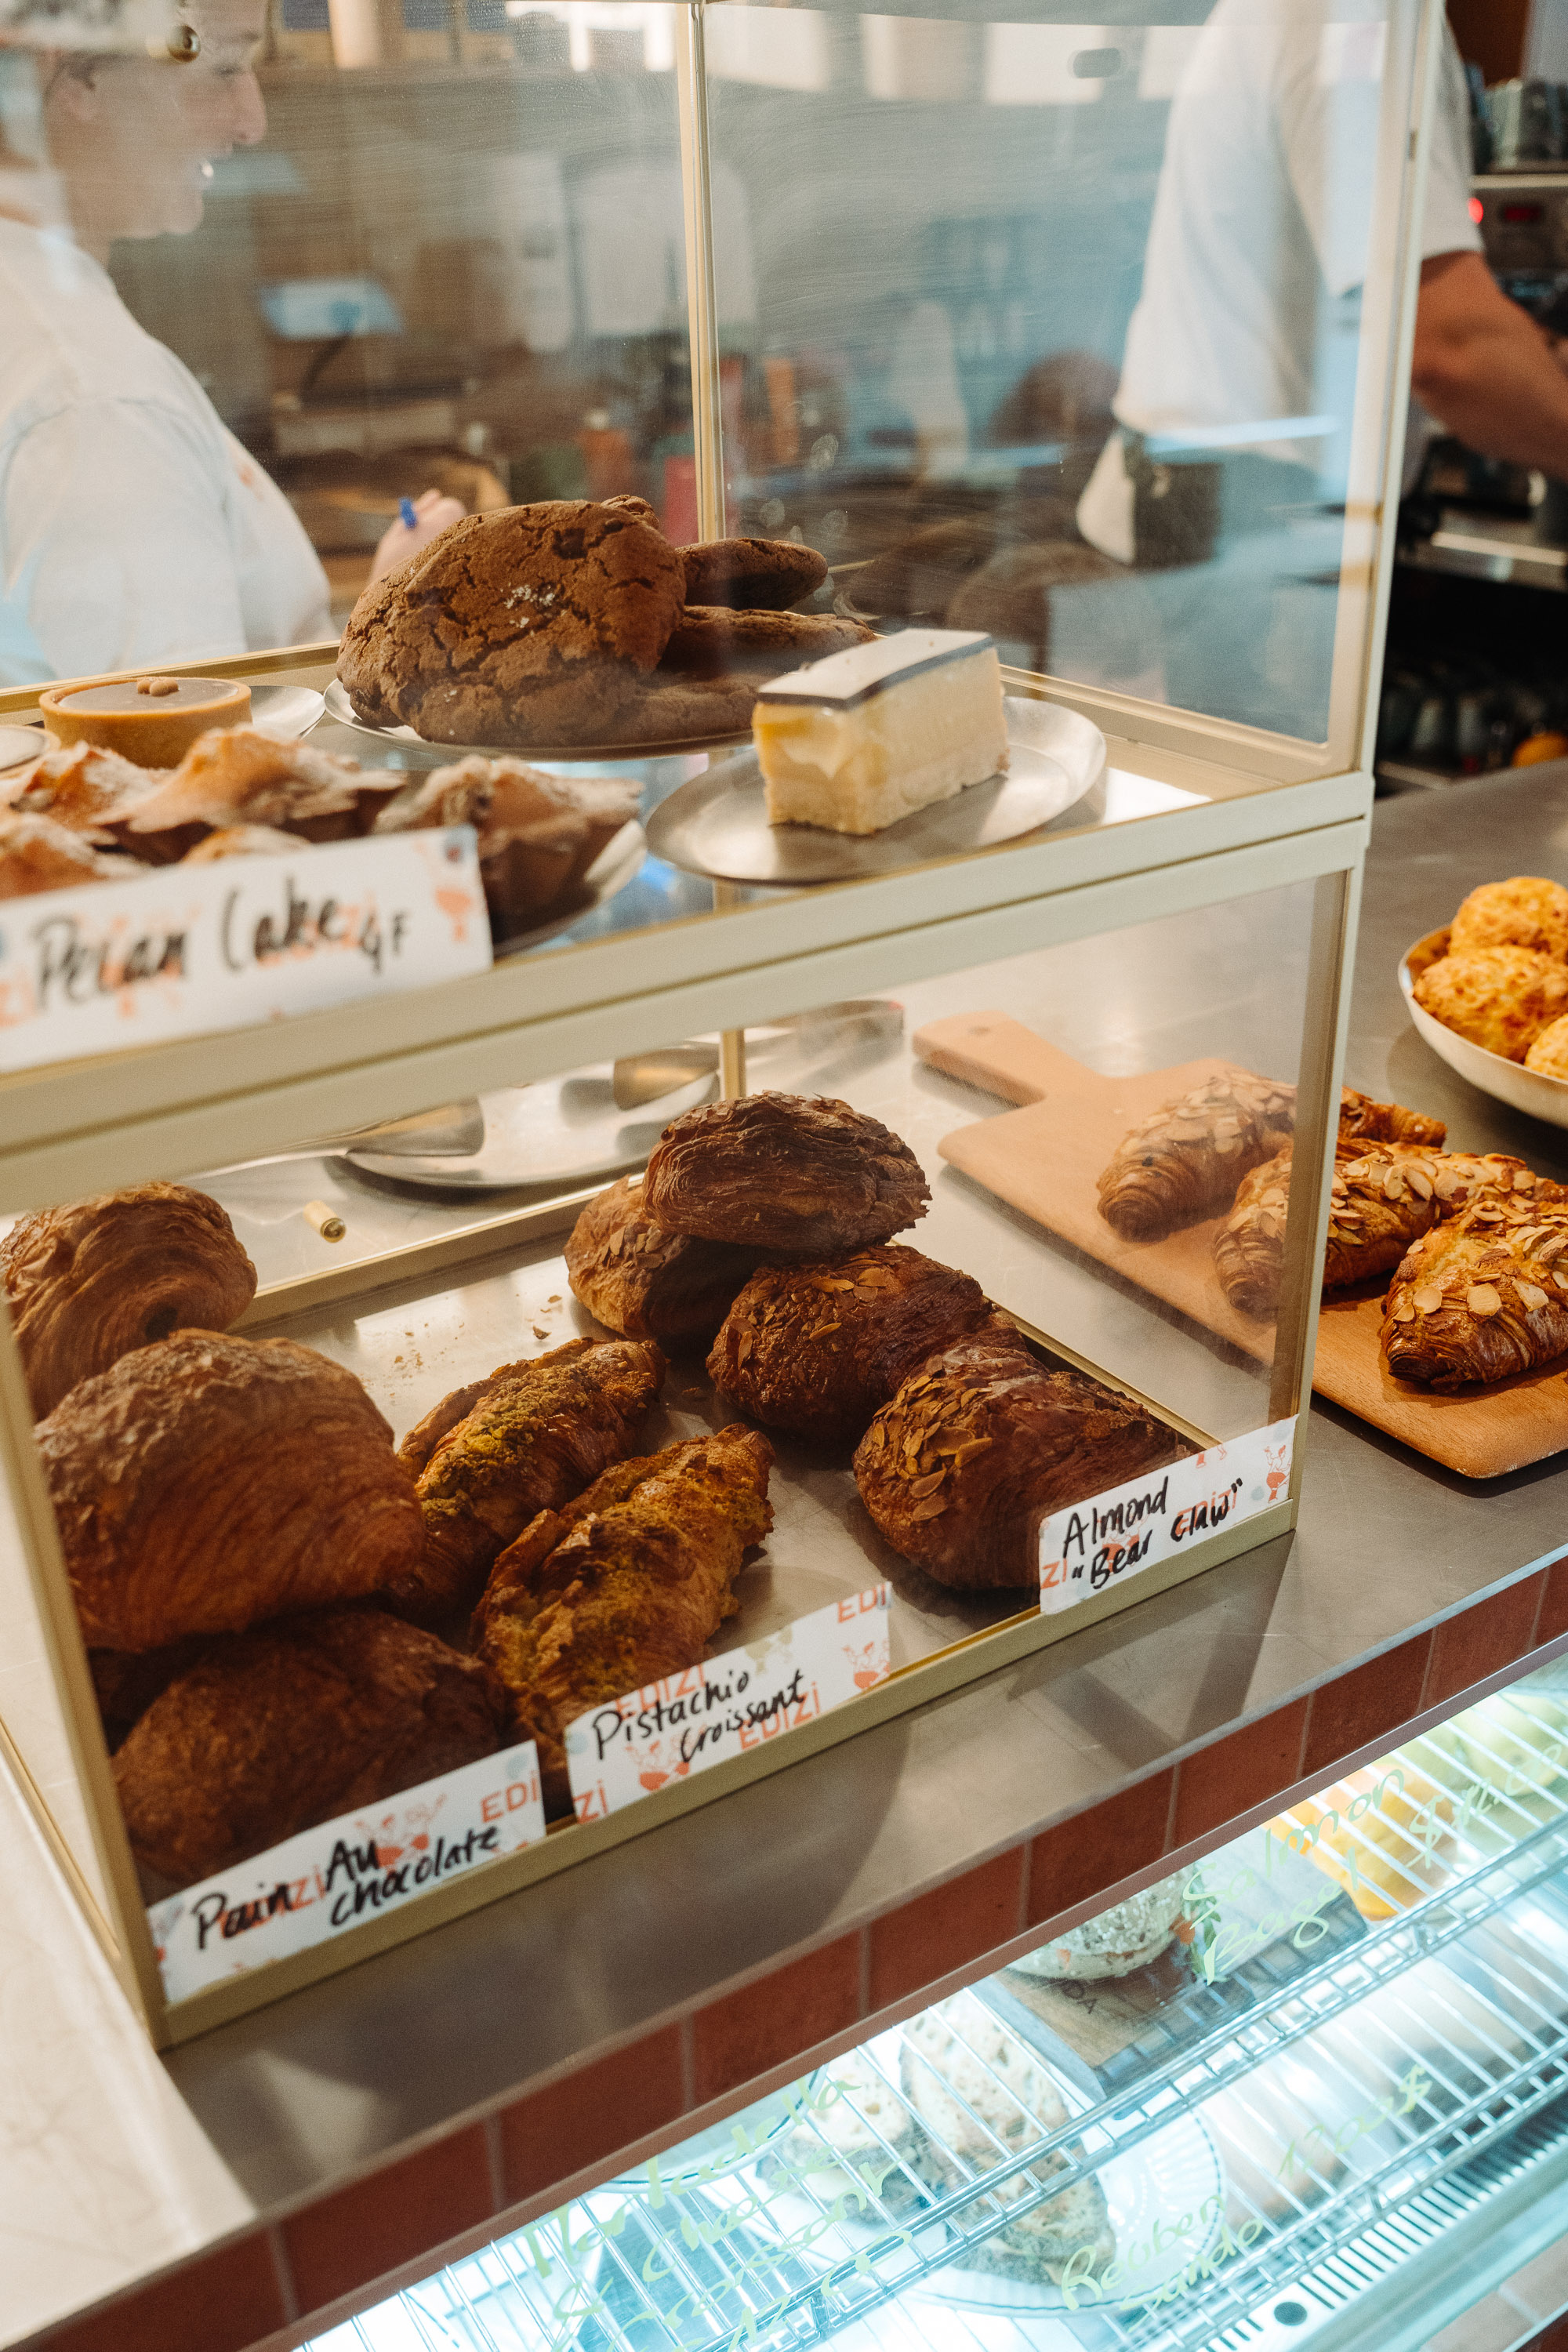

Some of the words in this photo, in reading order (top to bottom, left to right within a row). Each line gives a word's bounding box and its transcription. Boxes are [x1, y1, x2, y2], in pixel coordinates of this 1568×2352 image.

[223, 873, 345, 972] Cake
[1063, 1475, 1169, 1559] Almond
[1072, 1529, 1153, 1590] "Bear
[592, 1670, 750, 1761] Pistachio
[191, 1880, 294, 1951] Pain
[325, 1838, 380, 1891] Au
[1182, 1769, 1404, 1929] Salmon
[1203, 1845, 1360, 1987] Bagel
[1062, 2194, 1225, 2311] Reuben
